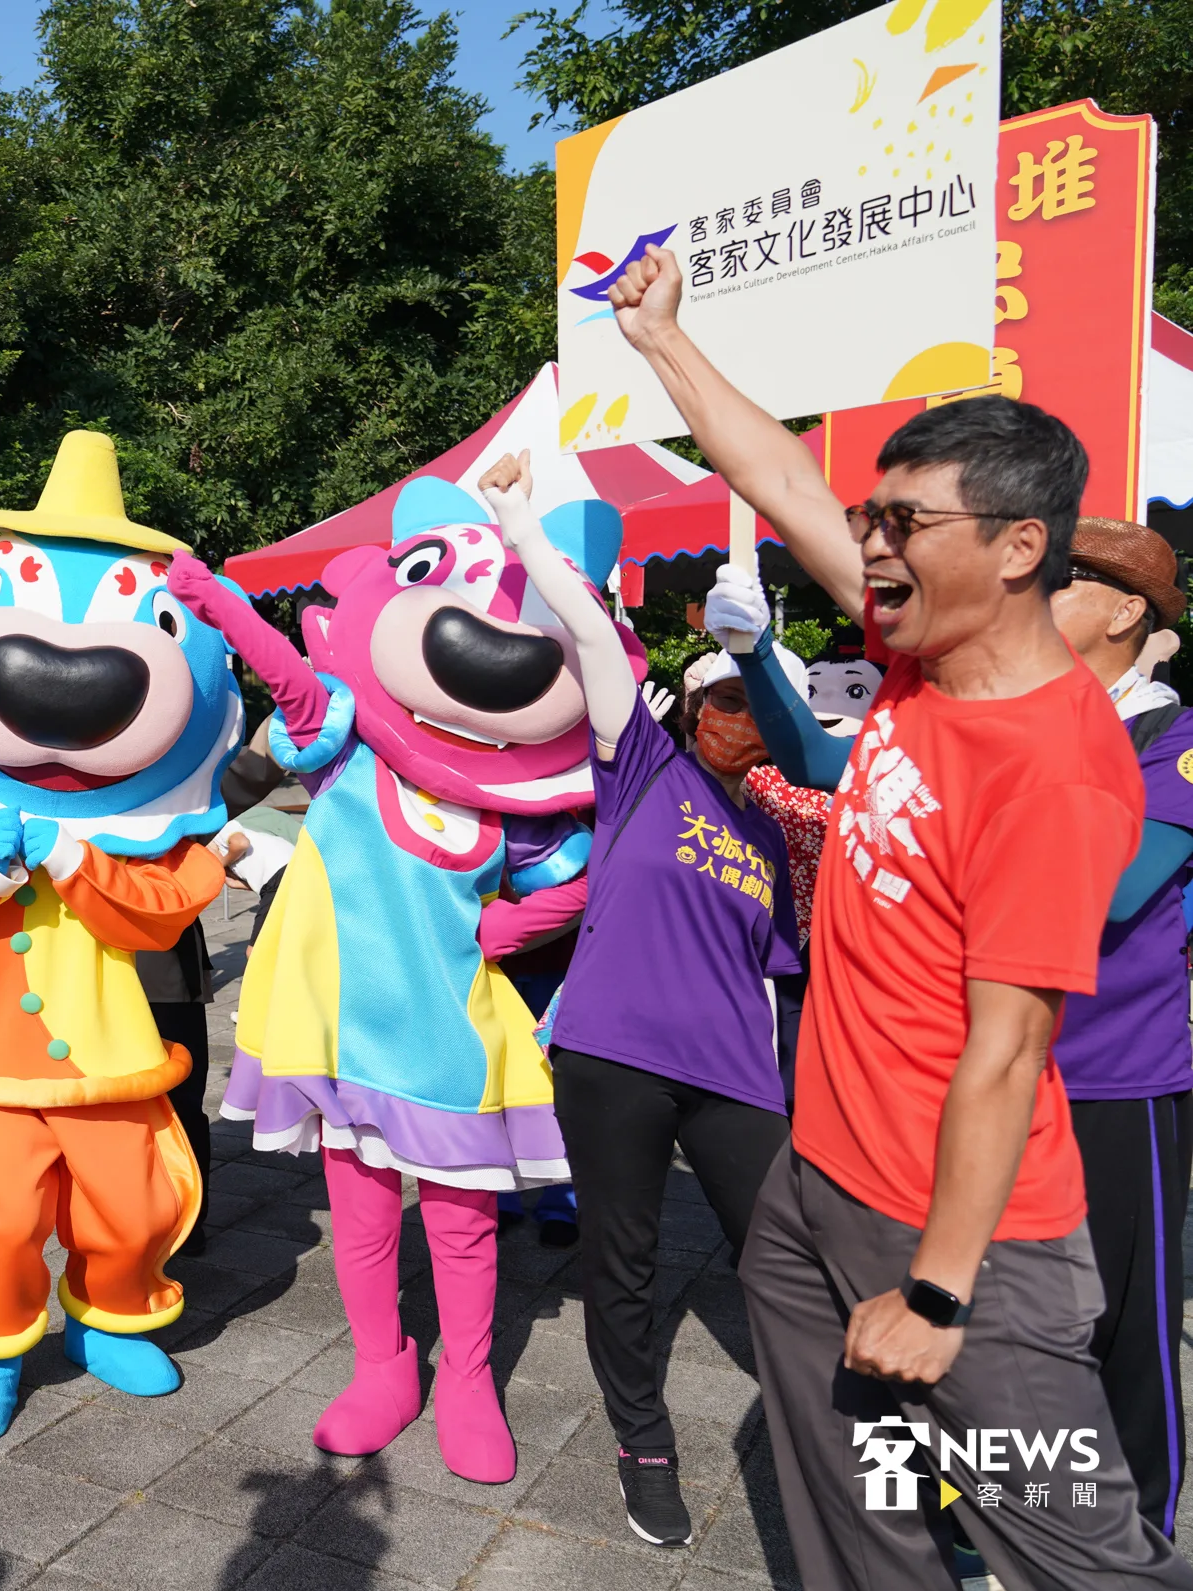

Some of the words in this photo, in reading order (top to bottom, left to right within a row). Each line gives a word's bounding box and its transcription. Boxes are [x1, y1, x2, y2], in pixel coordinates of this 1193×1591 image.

[689, 178, 821, 243] 客家委員會
[1007, 134, 1098, 221] 堆
[689, 173, 976, 288] 客家文化發展中心
[689, 290, 715, 303] Taiwan
[718, 284, 741, 297] Hakka
[744, 275, 774, 290] Culture
[776, 259, 833, 281] Development
[901, 234, 934, 249] Affairs
[938, 220, 976, 239] Council
[696, 856, 773, 909] 人偶劇團
